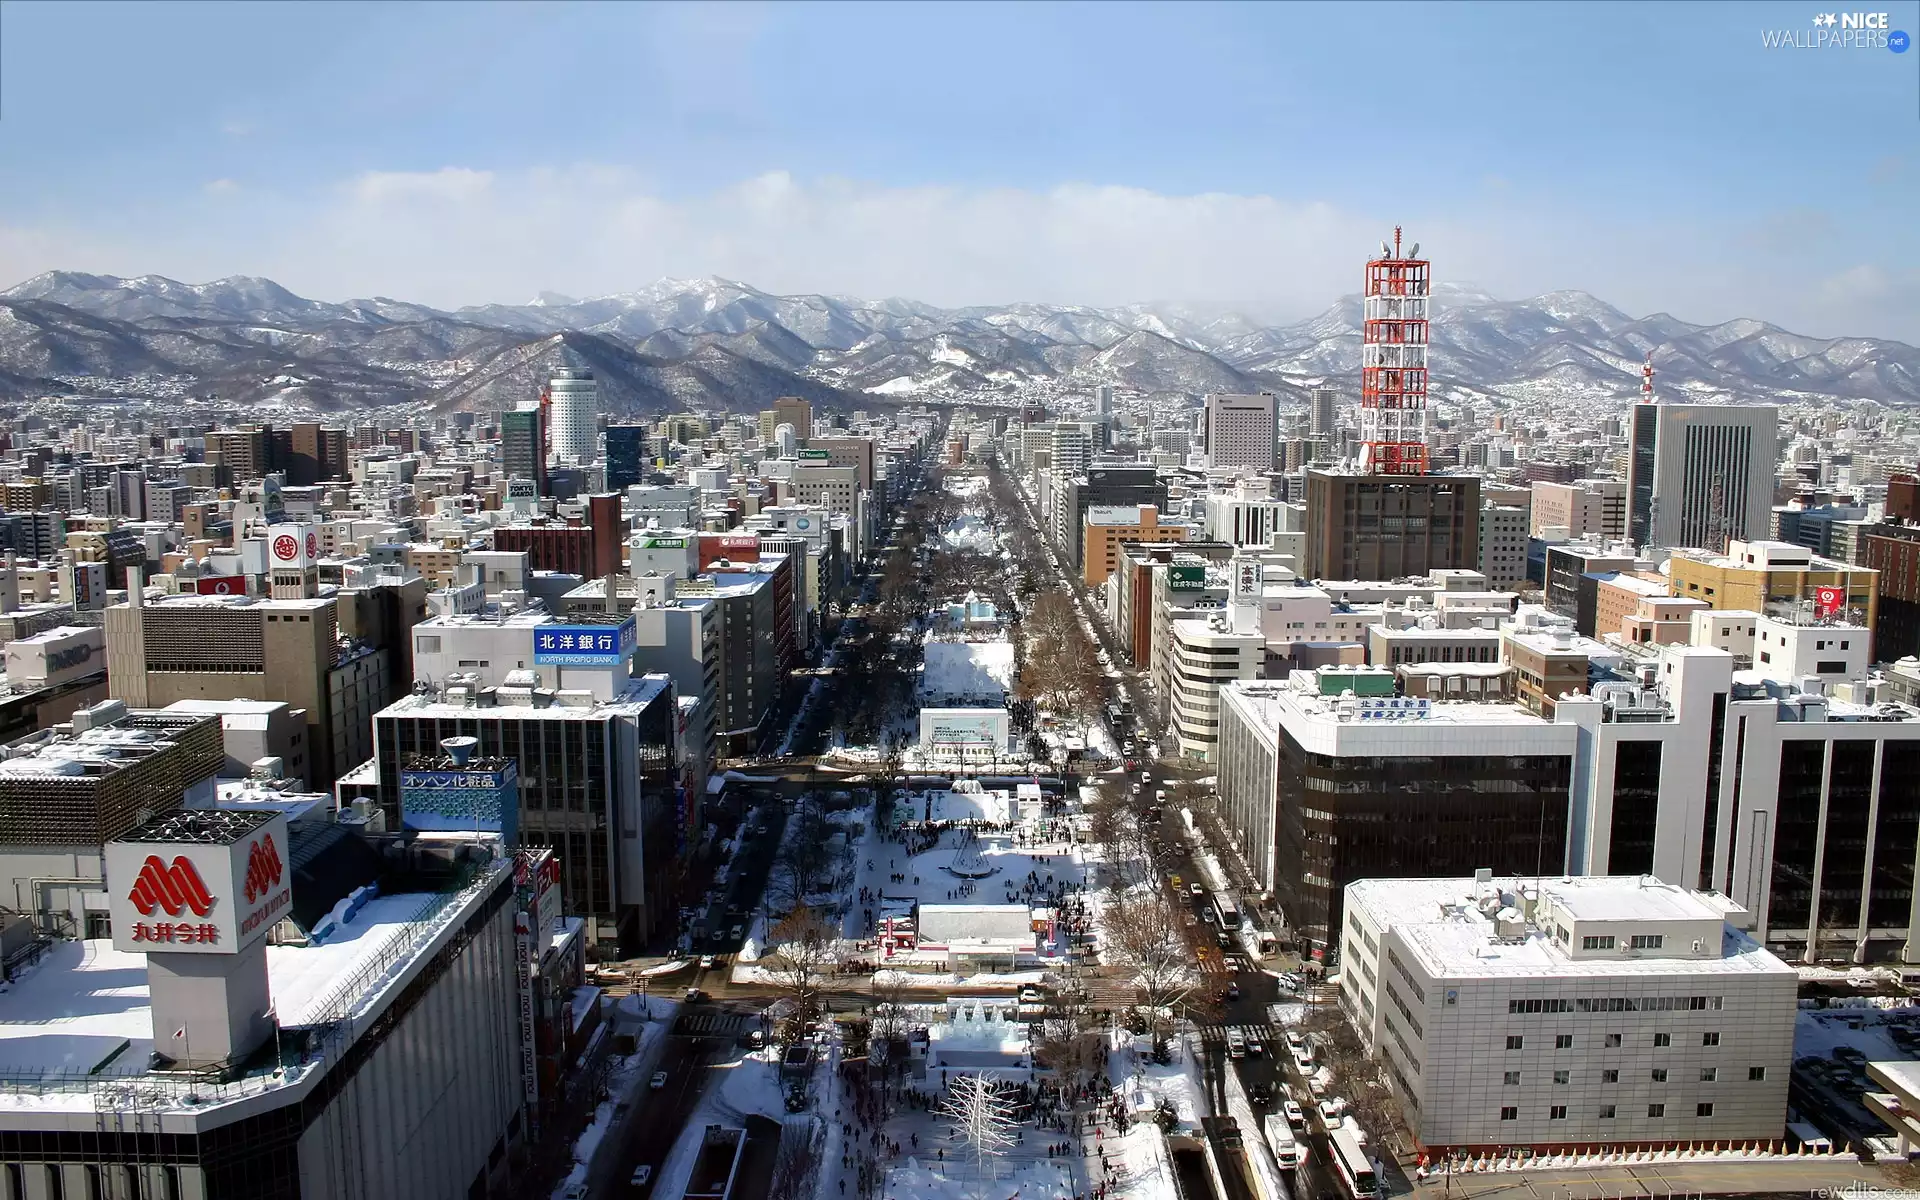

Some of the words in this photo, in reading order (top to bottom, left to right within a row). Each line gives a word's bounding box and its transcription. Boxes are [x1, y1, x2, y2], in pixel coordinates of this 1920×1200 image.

[340, 526, 346, 534] P
[1190, 528, 1197, 536] P
[540, 635, 613, 650] 北洋銀行
[594, 656, 613, 664] BANK
[1361, 700, 1427, 708] 北海道新聞
[403, 774, 496, 788] オッペン化粧品
[132, 922, 218, 943] 丸井今井
